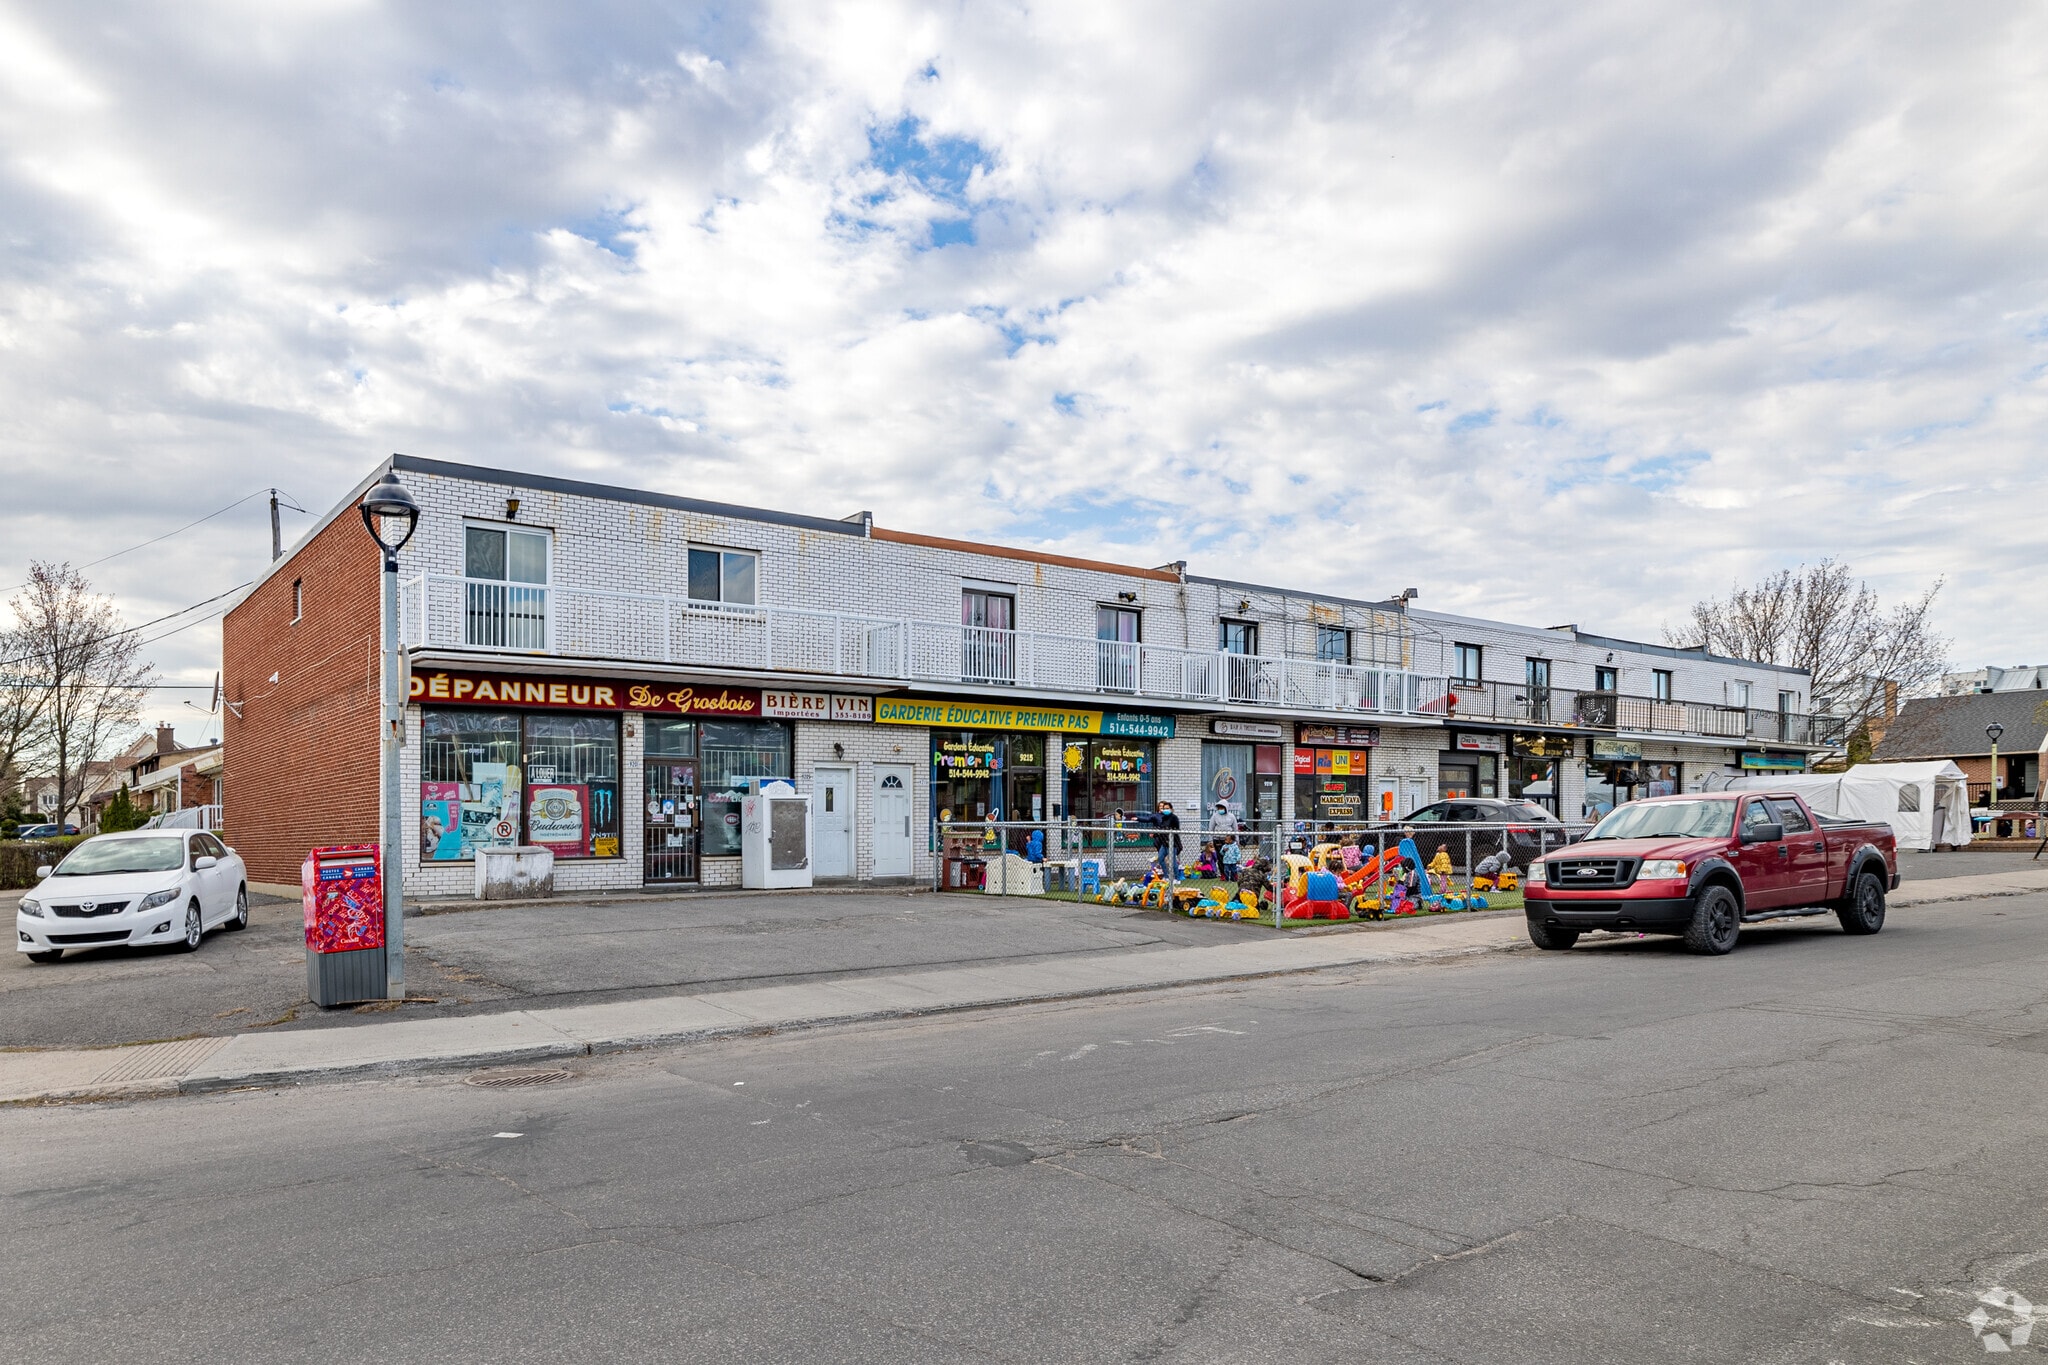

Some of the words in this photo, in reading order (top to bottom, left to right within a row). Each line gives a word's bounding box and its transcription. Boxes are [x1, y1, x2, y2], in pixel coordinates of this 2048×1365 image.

[409, 673, 616, 706] DÉPANNEUR
[667, 687, 755, 713] Grosbois
[765, 692, 826, 710] BIÈRE
[836, 698, 869, 711] VIN
[773, 709, 820, 719] importées
[879, 703, 943, 722] GARDERIE
[946, 704, 1012, 726] ÉDUCATIVE
[1015, 711, 1065, 728] PREMIER
[1068, 715, 1090, 730] PAS
[1117, 712, 1138, 723] Enfants
[1139, 714, 1151, 723] 0-5
[1151, 716, 1162, 724] ans
[1109, 723, 1169, 737] 514-544-9942
[933, 751, 982, 768] Premier
[985, 753, 1004, 769] Pas
[1094, 756, 1134, 772] Premier
[1136, 757, 1152, 774] Pas
[1318, 754, 1332, 768] Ria
[1335, 755, 1348, 765] UNI
[536, 767, 555, 779] LOUER
[1328, 807, 1353, 816] EXPRESS
[528, 820, 583, 831] Budweiser
